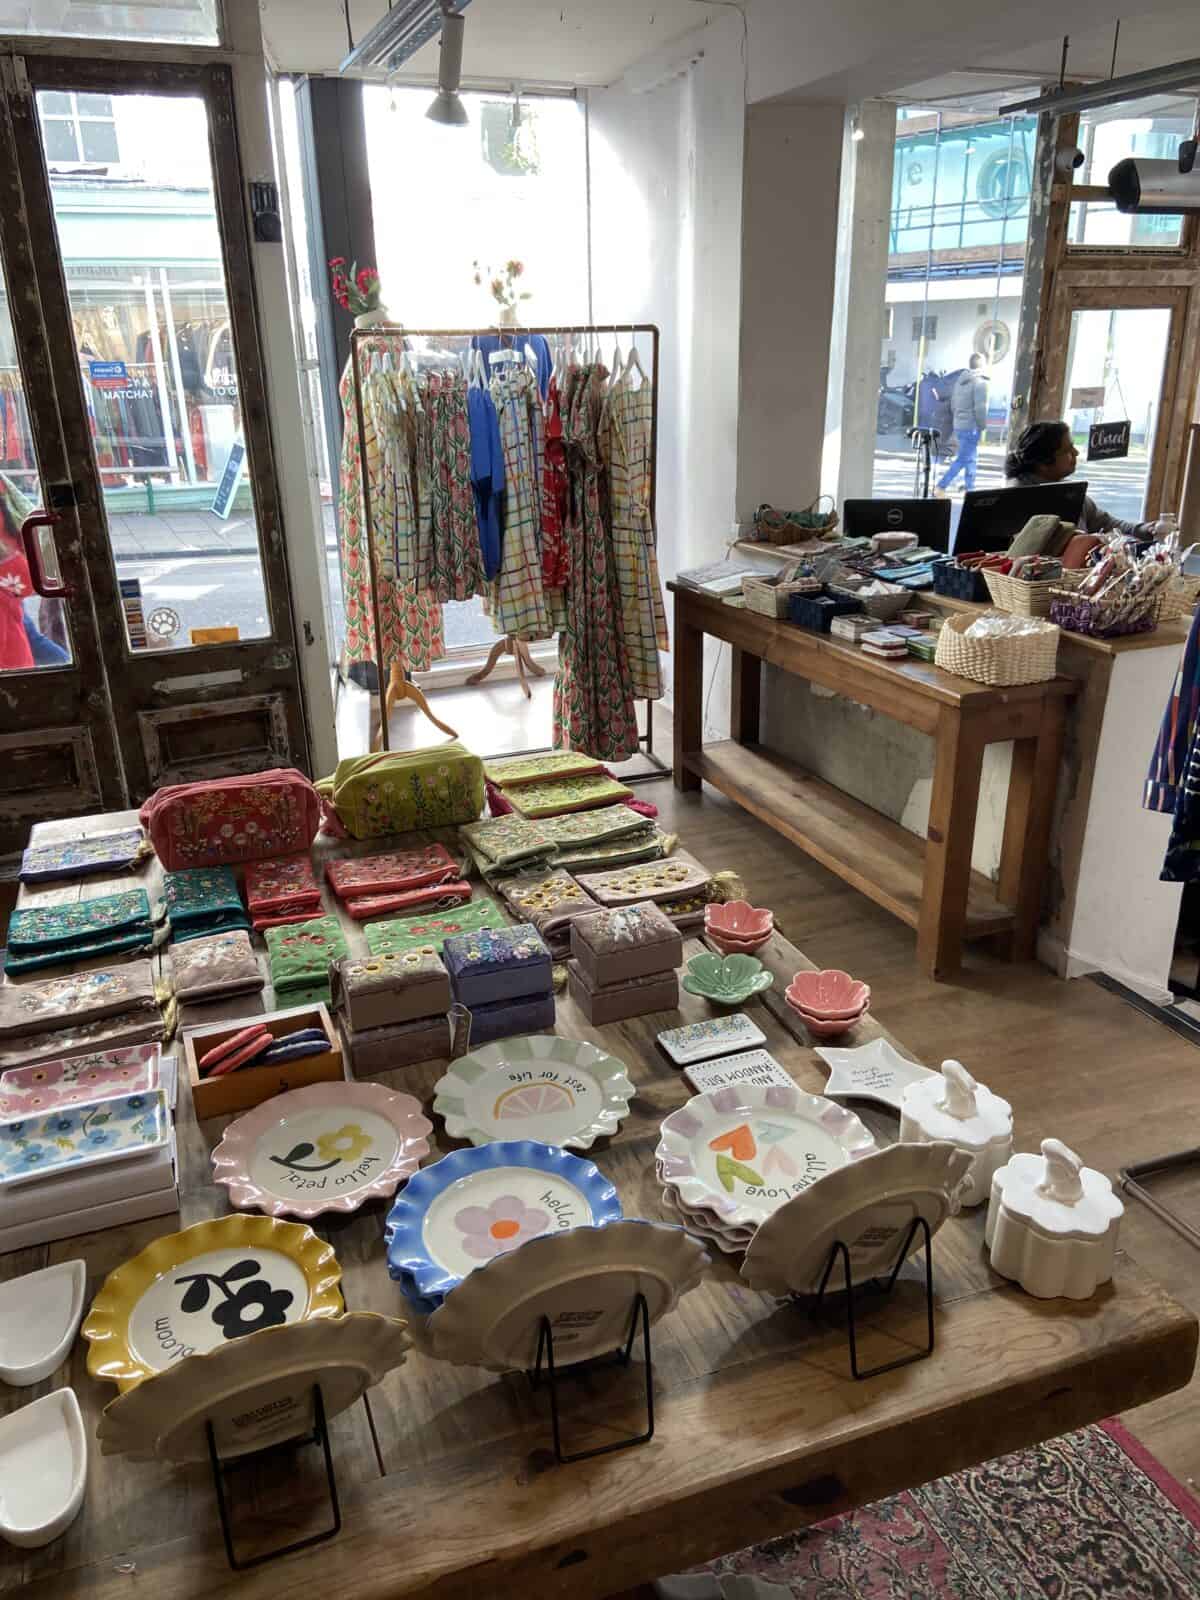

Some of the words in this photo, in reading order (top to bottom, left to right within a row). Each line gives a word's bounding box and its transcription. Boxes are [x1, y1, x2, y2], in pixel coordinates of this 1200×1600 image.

[1090, 425, 1128, 449] Closed
[538, 1071, 560, 1082] for
[725, 1062, 773, 1081] RANDOM
[335, 1156, 381, 1185] hello
[804, 1152, 827, 1173] all
[279, 1170, 328, 1189] petal
[539, 1189, 576, 1228] hello
